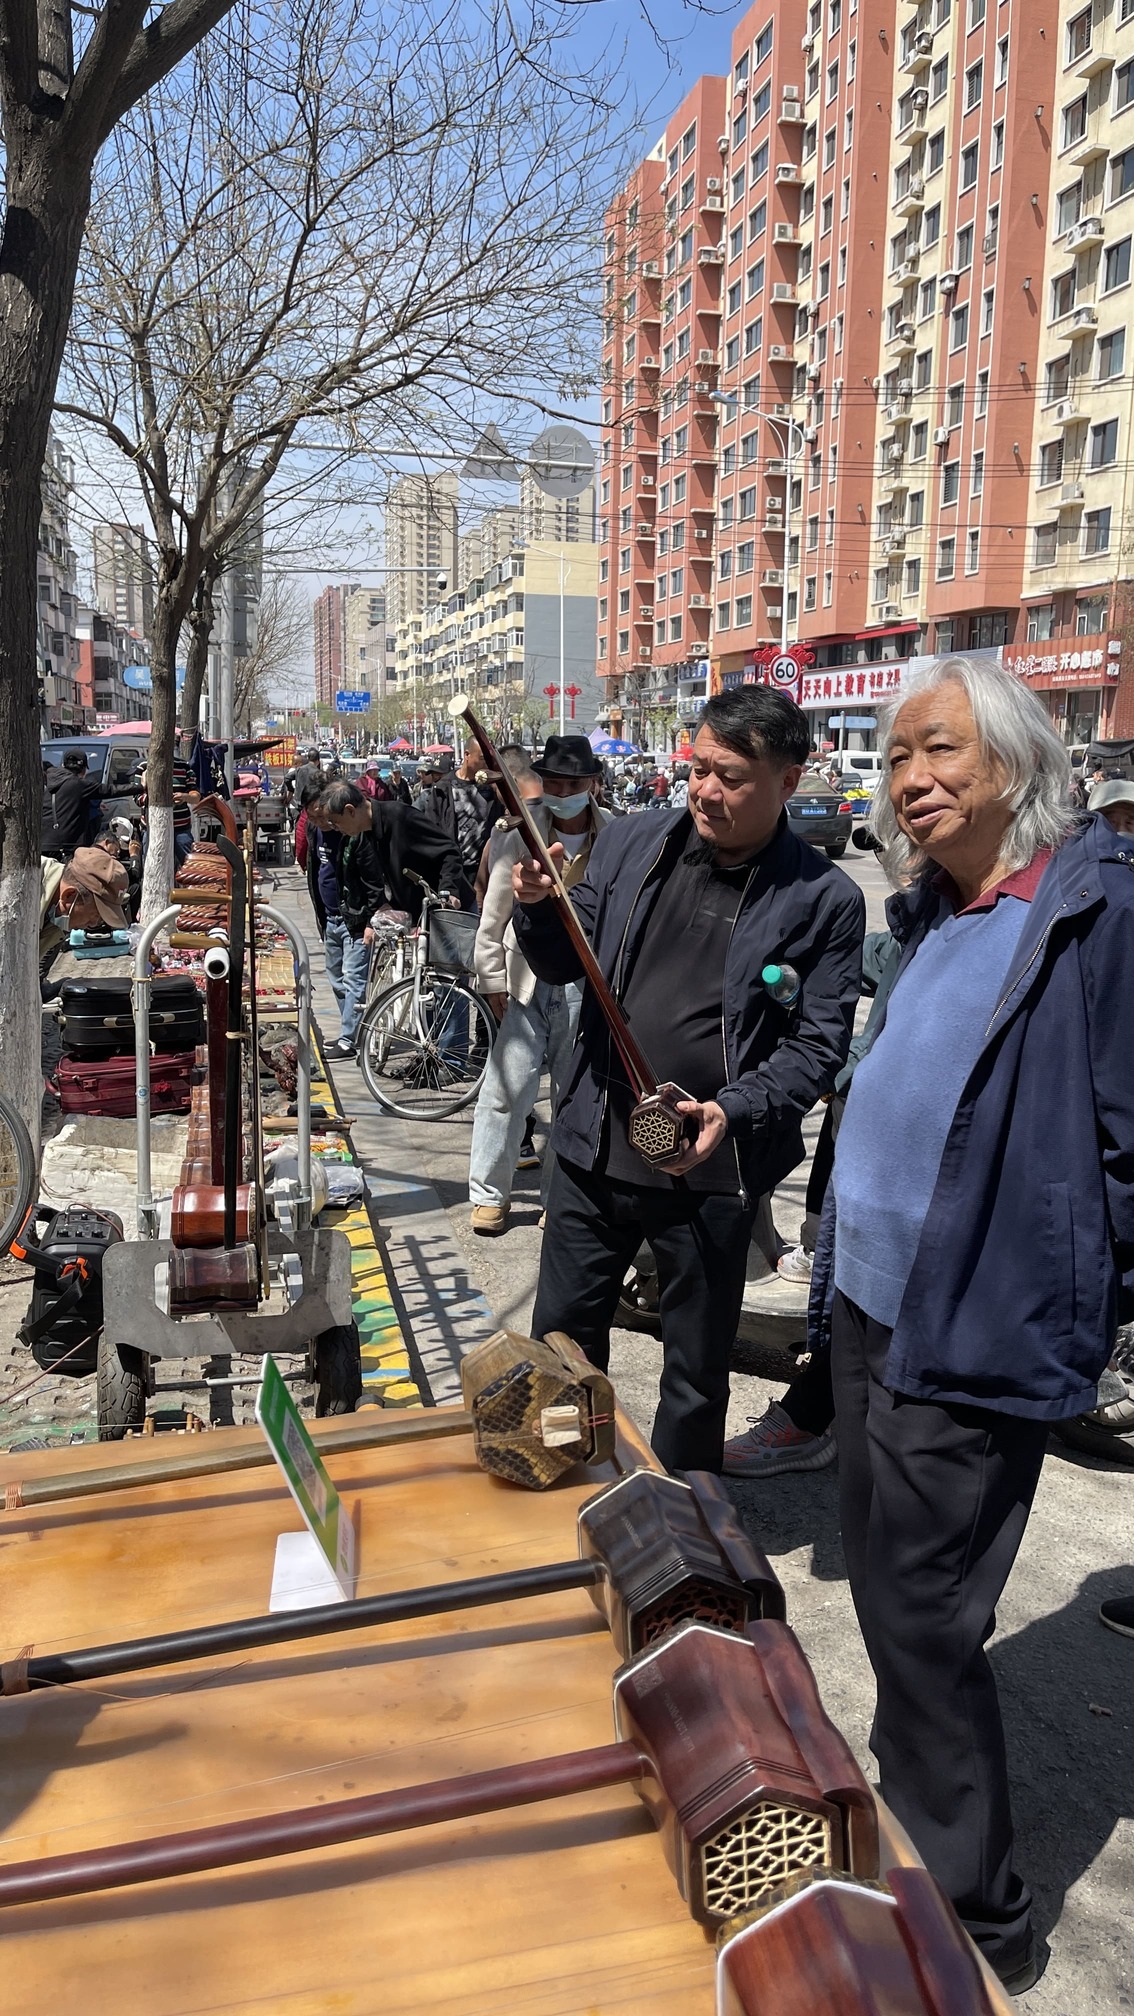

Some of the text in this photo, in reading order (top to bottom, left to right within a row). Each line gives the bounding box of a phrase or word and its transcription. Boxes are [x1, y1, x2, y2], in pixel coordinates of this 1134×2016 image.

[775, 662, 795, 678] 60
[803, 672, 866, 700] 天天向上教育
